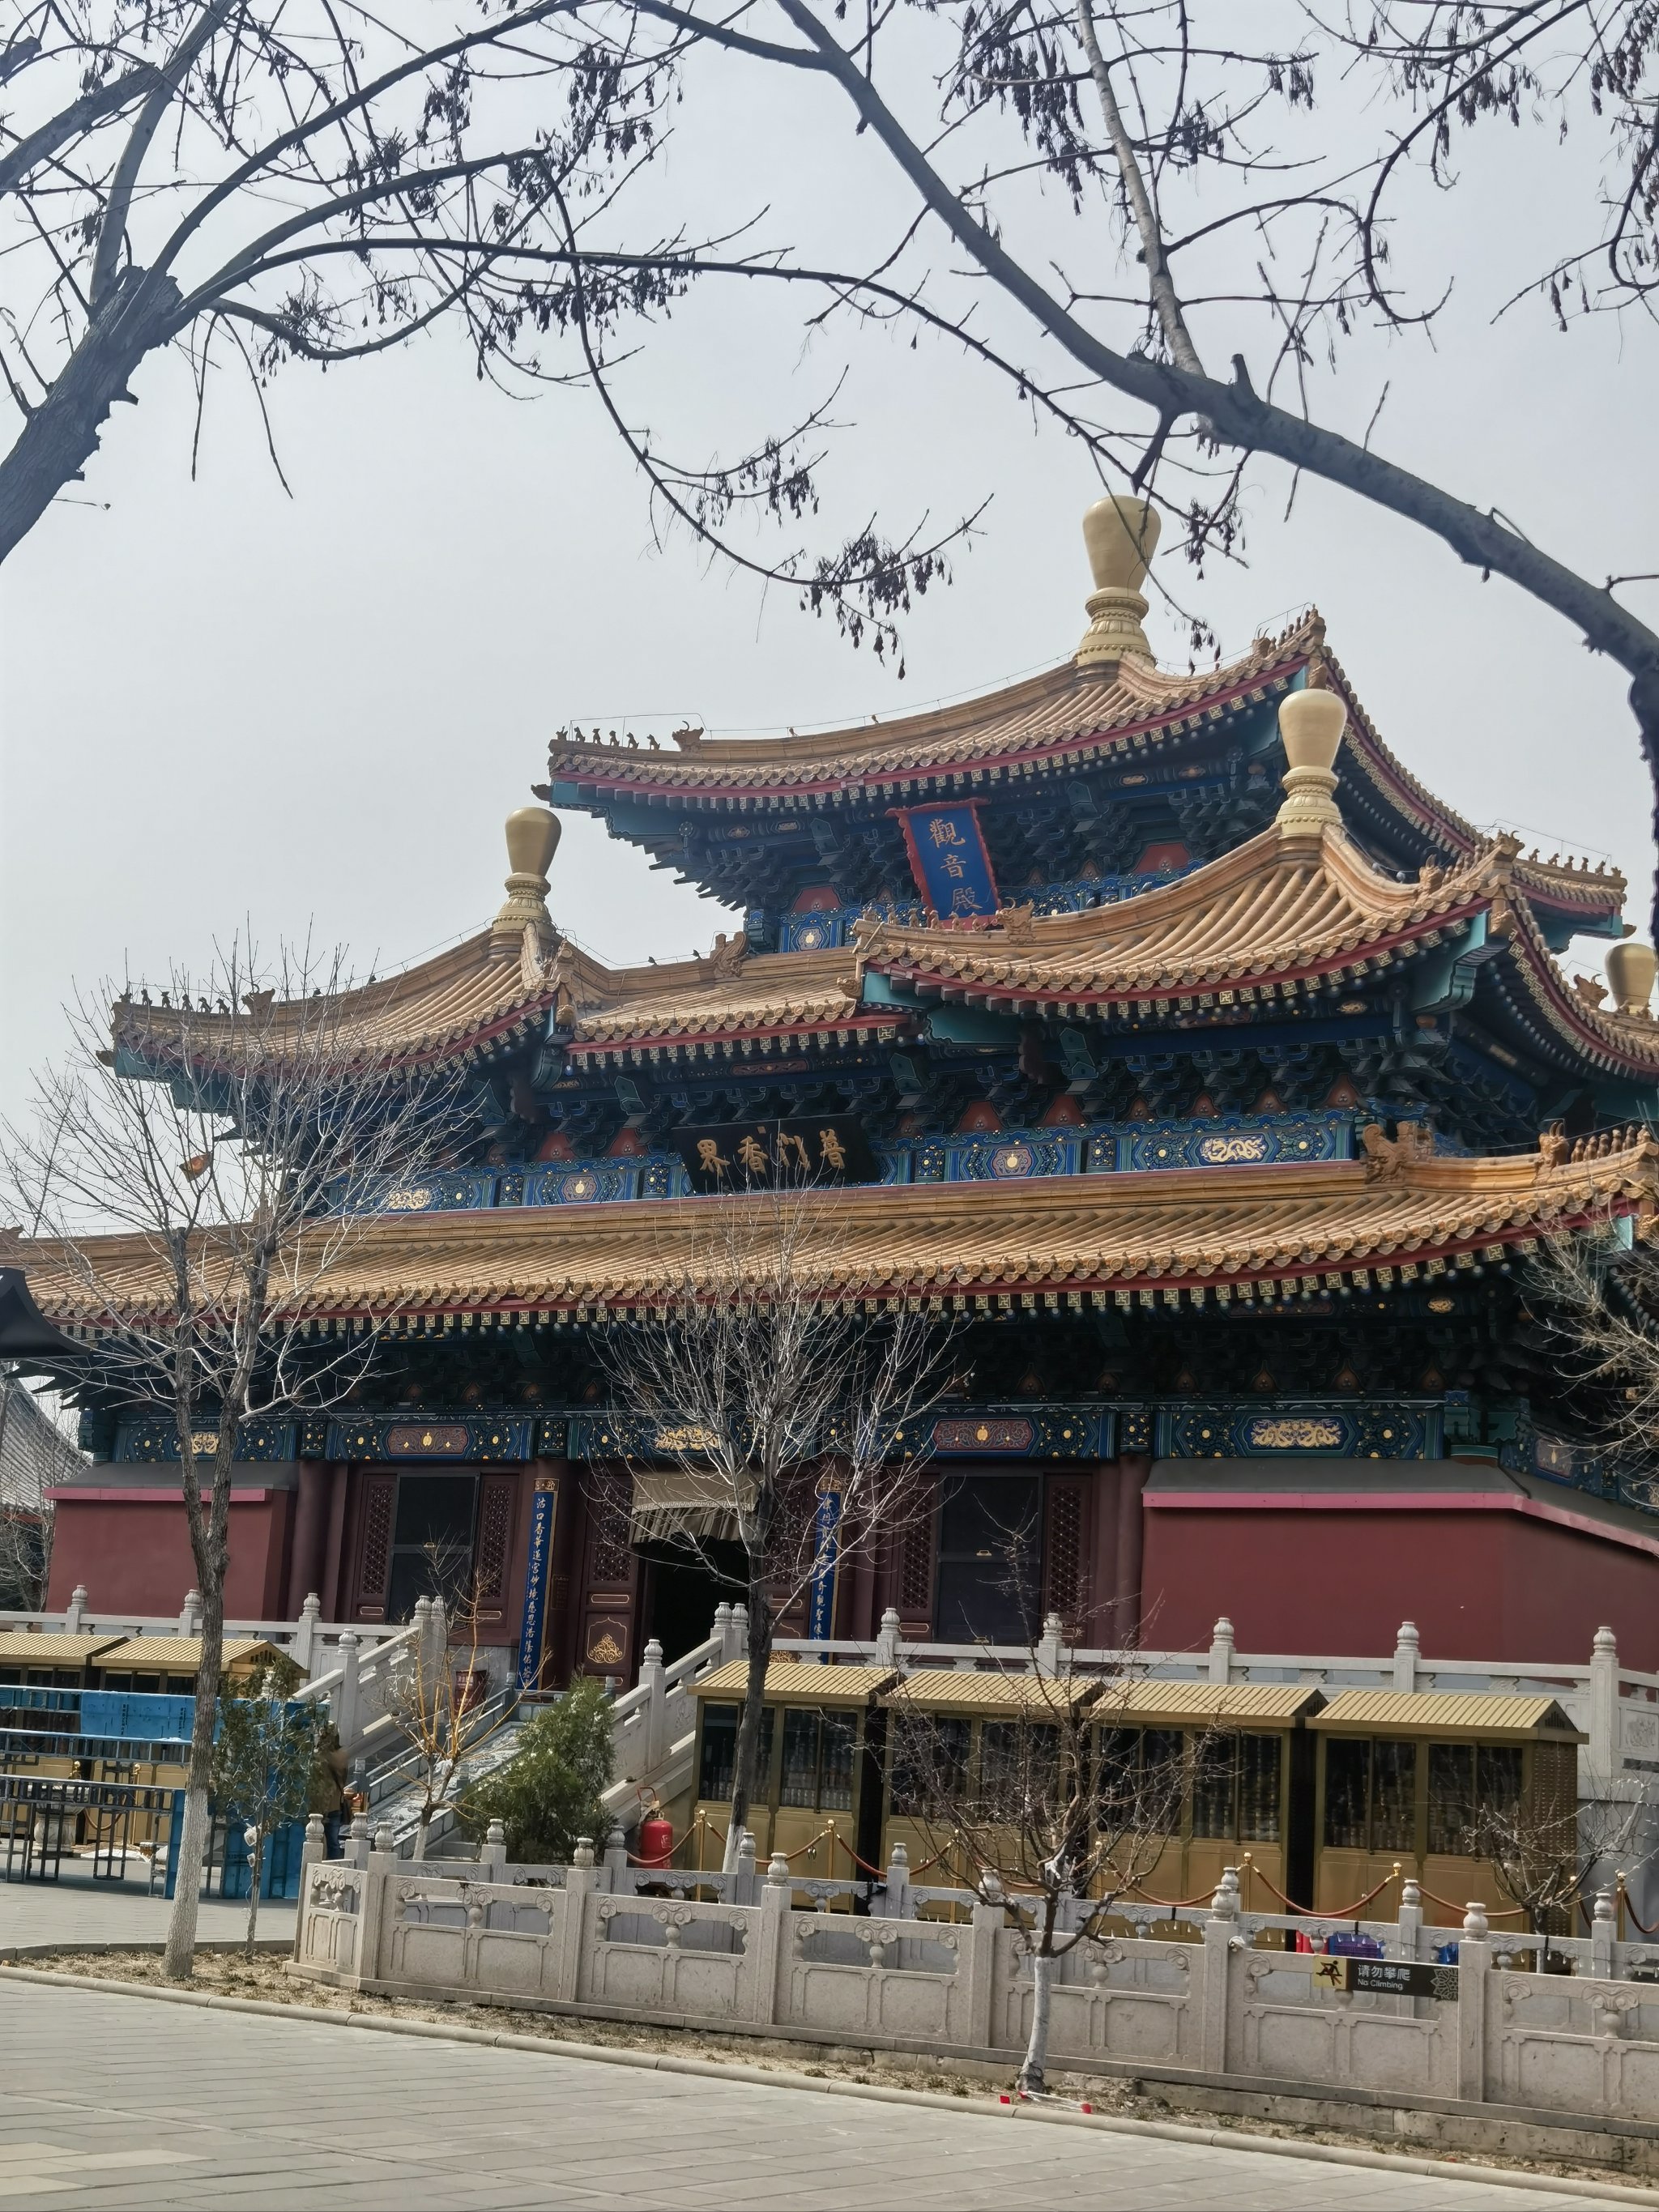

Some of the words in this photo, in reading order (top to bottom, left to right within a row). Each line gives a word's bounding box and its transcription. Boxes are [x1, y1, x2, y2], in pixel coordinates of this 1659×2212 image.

[928, 818, 983, 912] 觀音殿
[1358, 1964, 1411, 1981] 请勿攀爬
[1357, 1978, 1368, 1986] No
[1370, 1979, 1404, 1991] Climbing
